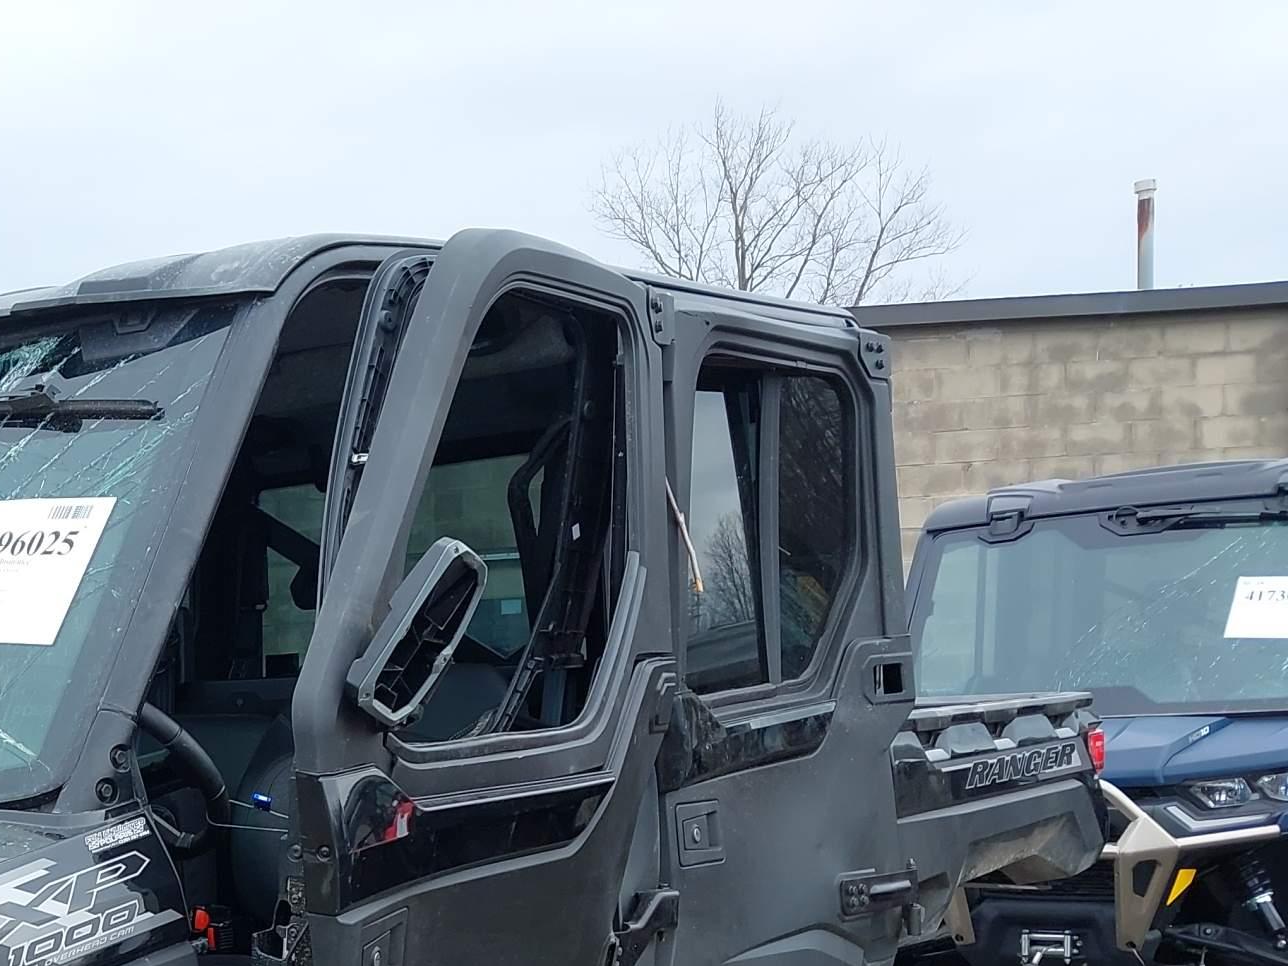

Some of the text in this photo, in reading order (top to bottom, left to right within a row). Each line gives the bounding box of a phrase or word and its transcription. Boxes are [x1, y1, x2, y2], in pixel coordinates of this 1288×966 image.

[1244, 590, 1288, 602] 4173
[965, 741, 1076, 790] RANGER
[44, 936, 108, 966] OVERHEAD
[109, 926, 135, 941] CAM
